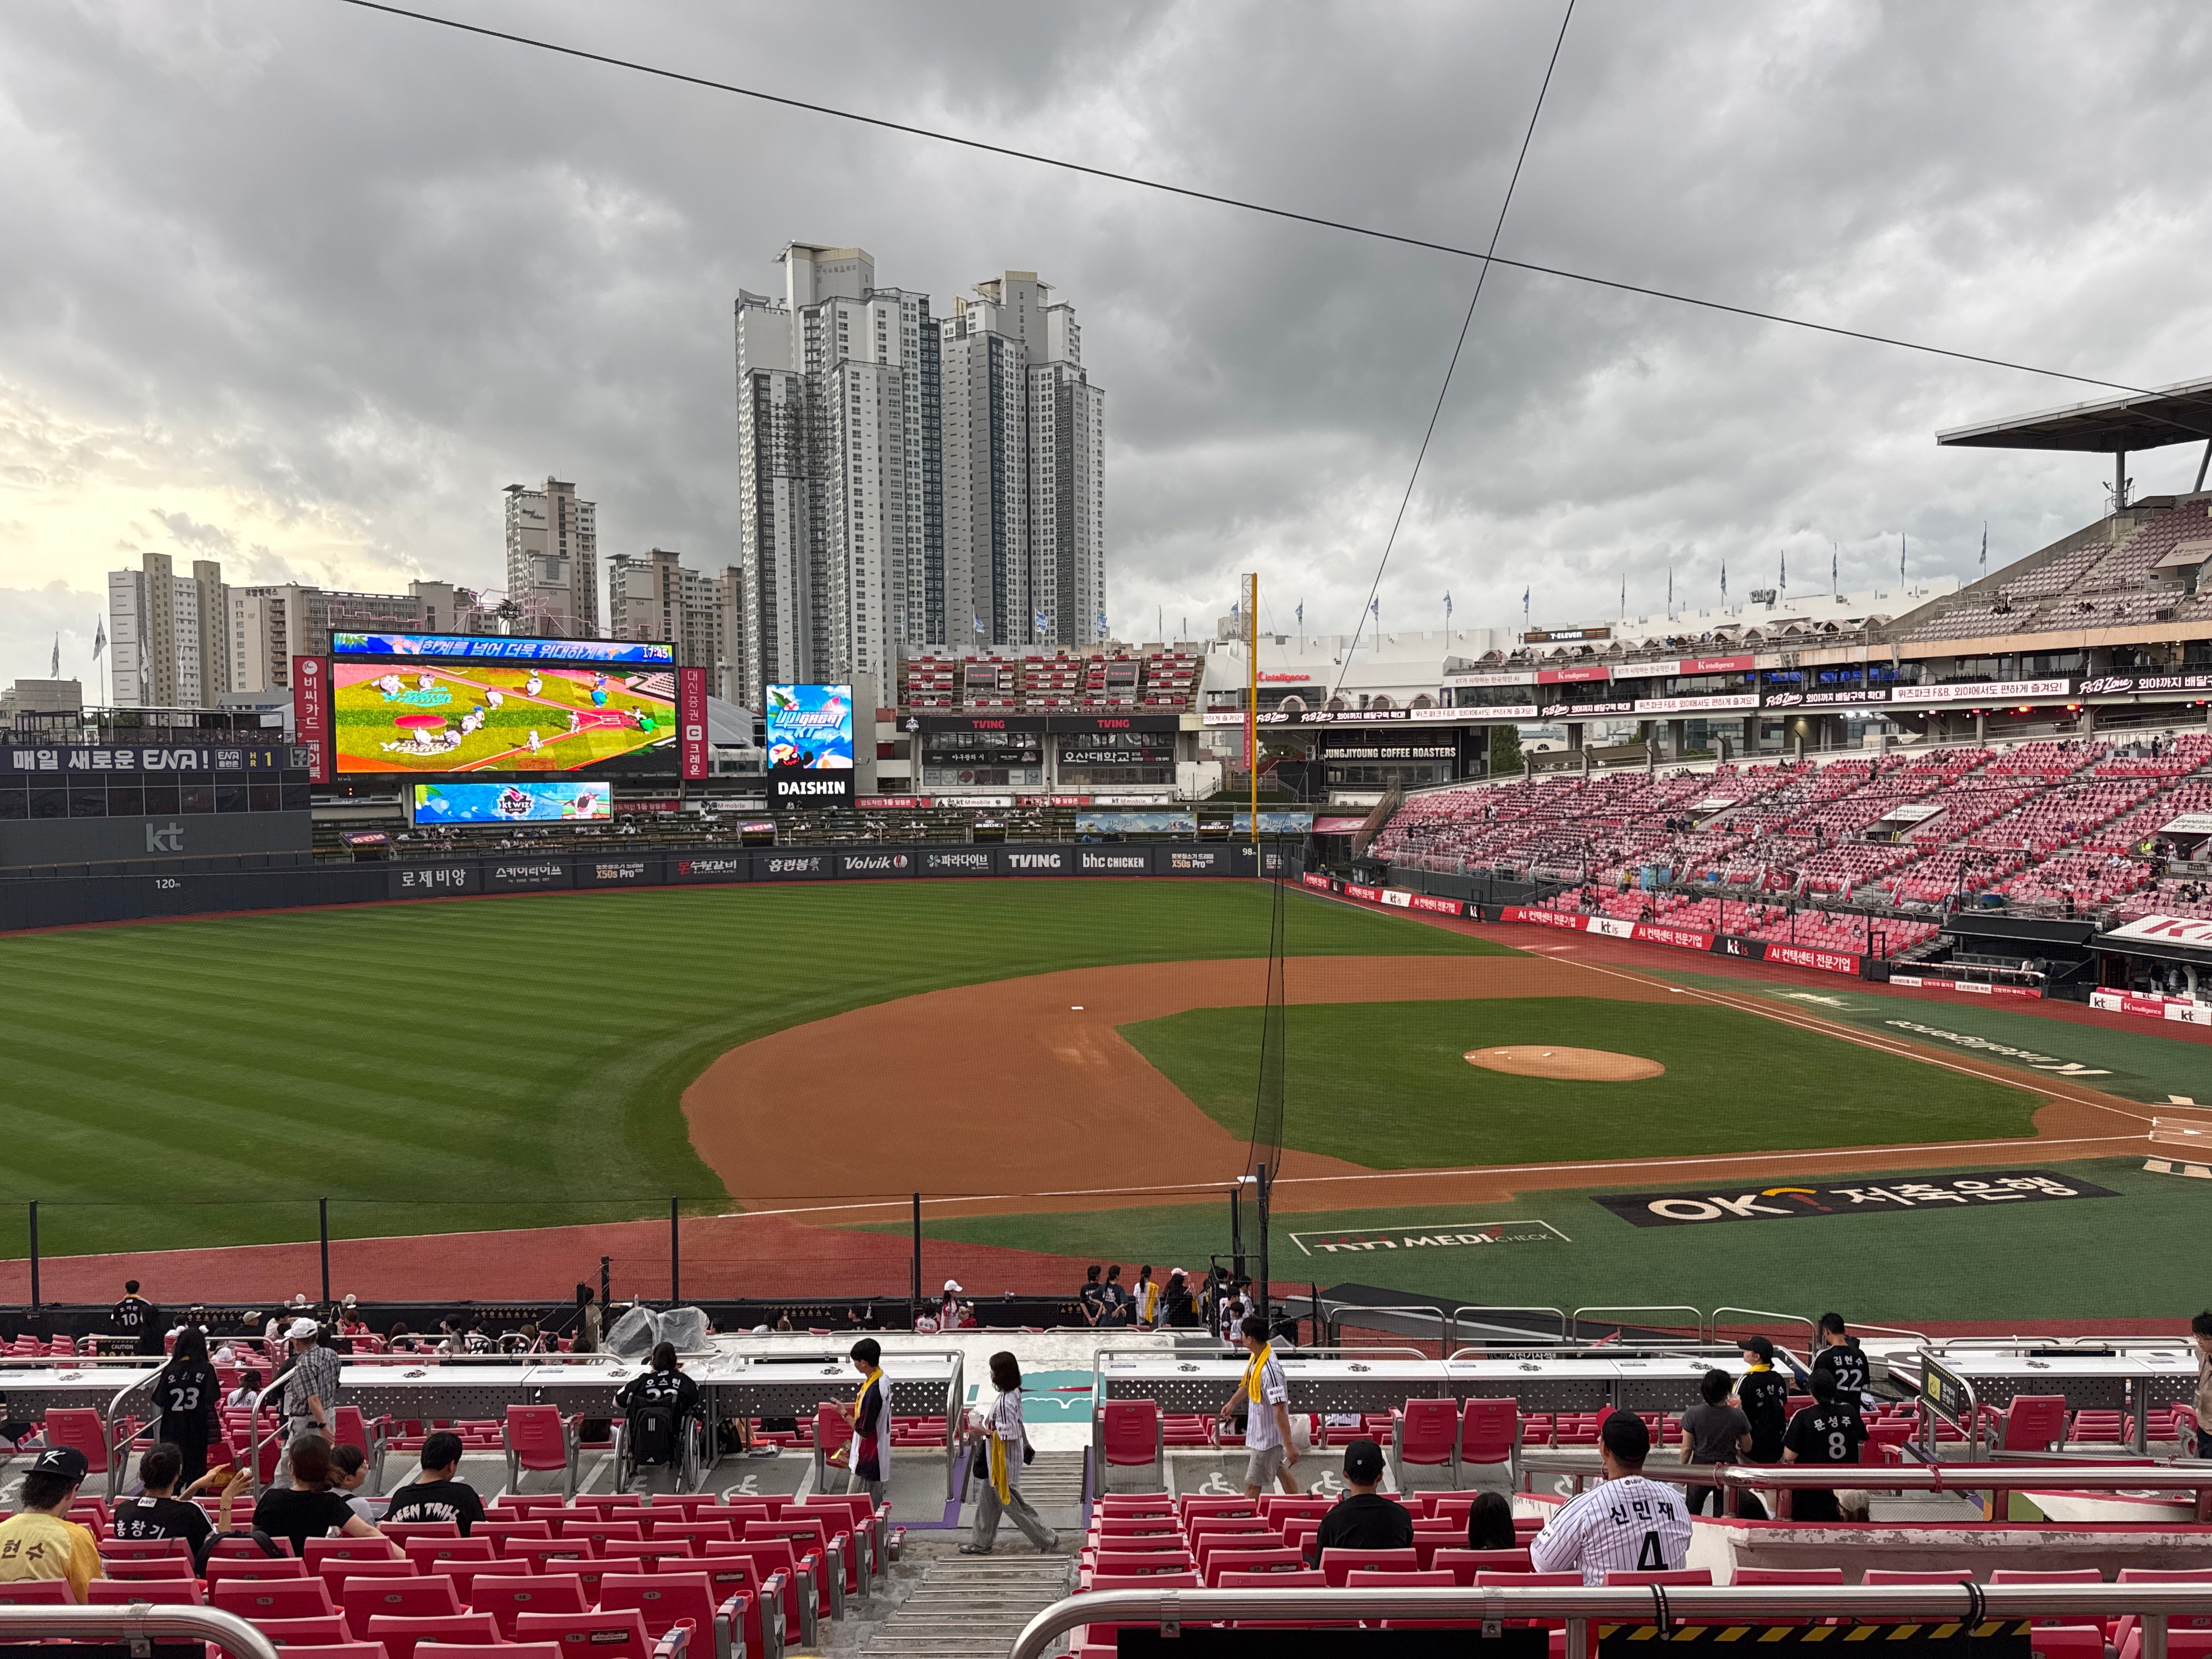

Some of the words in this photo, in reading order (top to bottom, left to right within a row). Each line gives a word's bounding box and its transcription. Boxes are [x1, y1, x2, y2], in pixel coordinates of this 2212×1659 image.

[1550, 631, 1583, 640] 7-ELEVEN
[421, 640, 469, 655] 한계를
[472, 641, 505, 657] 넘어
[506, 642, 537, 657] 더욱
[642, 646, 668, 659] 17:45
[1698, 661, 1705, 670] K
[1706, 662, 1735, 670] intelligence
[1265, 673, 1310, 683] intelligence
[1558, 671, 1564, 680] K
[1898, 689, 1931, 698] 위즈파크
[1954, 685, 1997, 696] 외야에서도
[2001, 684, 2028, 694] 편하게
[2031, 682, 2062, 692] 즐겨요!
[2077, 679, 2104, 695] F&B
[2102, 676, 2133, 693] Zone
[2138, 678, 2181, 690] 외야까지
[687, 670, 699, 721] 대신증권
[1765, 695, 1784, 708] F&B
[1782, 692, 1803, 707] Zone
[1806, 693, 1834, 703] 외야까지
[1836, 692, 1866, 702] 배달구역
[1867, 690, 1886, 700] 확대!
[304, 677, 320, 729] 비씨카드
[1639, 701, 1662, 709] 위즈파크
[1679, 699, 1711, 708] 외야에서도
[1712, 698, 1731, 707] 편하게
[1733, 697, 1754, 706] 즐겨요!
[1256, 713, 1271, 723] F&B
[1270, 712, 1289, 723] Zone
[1300, 713, 1317, 723] F&B
[1315, 712, 1334, 723] Zone
[1541, 706, 1555, 716] F&B
[972, 719, 1005, 729] TVING
[1097, 719, 1130, 729] TVING
[13, 750, 58, 770] 매일
[68, 750, 135, 770] 새로운
[218, 751, 239, 760] ENA
[264, 752, 272, 766] 1
[689, 743, 700, 775] 크레온
[1063, 752, 1130, 763] 오산대학교
[1324, 748, 1379, 759] JUNGJIYOUNG
[1381, 747, 1410, 758] COFFEE
[1413, 747, 1456, 758] ROASTERS
[778, 782, 845, 795] DAISHIN
[146, 822, 184, 853] kt
[769, 858, 809, 872] 홈런볼
[844, 856, 891, 870] Volvik
[941, 854, 989, 867] 파라다이브
[1008, 854, 1061, 868] TVING
[1082, 853, 1105, 868] bhc
[1107, 856, 1144, 868] CHICKEN
[1171, 859, 1192, 868] X50s
[1192, 860, 1206, 868] Pro
[495, 862, 562, 878] 스카이라이프
[596, 870, 618, 879] X50s
[619, 869, 635, 878] Pro
[402, 869, 466, 888] 로제비앙
[1390, 893, 1397, 903] kt
[1419, 898, 1437, 910] 컨택센터
[1437, 901, 1455, 913] 전문기업
[1470, 905, 1477, 917] kt
[1518, 910, 1526, 919] AI
[1528, 910, 1553, 923] 컨택센터
[1553, 914, 1576, 927] 전문기업
[1601, 921, 1611, 933] kt
[1611, 925, 1618, 935] is
[1639, 928, 1646, 936] AI
[1646, 928, 1673, 943] 컨택센터
[1675, 931, 1702, 948] 전문기업
[1727, 939, 1740, 955] kt
[1771, 947, 1780, 959] AI
[1781, 948, 1814, 966] 컨택센터
[1816, 952, 1851, 972] 전문기업
[2094, 997, 2106, 1008] kt
[2124, 1002, 2131, 1011] K
[2131, 1005, 2162, 1015] intelligence
[2181, 1009, 2194, 1022] kt
[1884, 1019, 2061, 1063] intelligence
[1647, 1194, 1794, 1222] OK
[1830, 1176, 2079, 1205] 저축은행
[1403, 1233, 1496, 1248] MEDI
[121, 1313, 138, 1326] 10
[1833, 1355, 1864, 1366] 김현수
[645, 1378, 681, 1389] 오스틴
[1835, 1368, 1863, 1392] 22
[170, 1387, 200, 1412] 23
[1813, 1415, 1852, 1431] 문성주
[1829, 1431, 1846, 1459] 8
[1610, 1500, 1675, 1525] 신민재
[116, 1519, 166, 1539] 홍창기
[1637, 1531, 1668, 1571] 4
